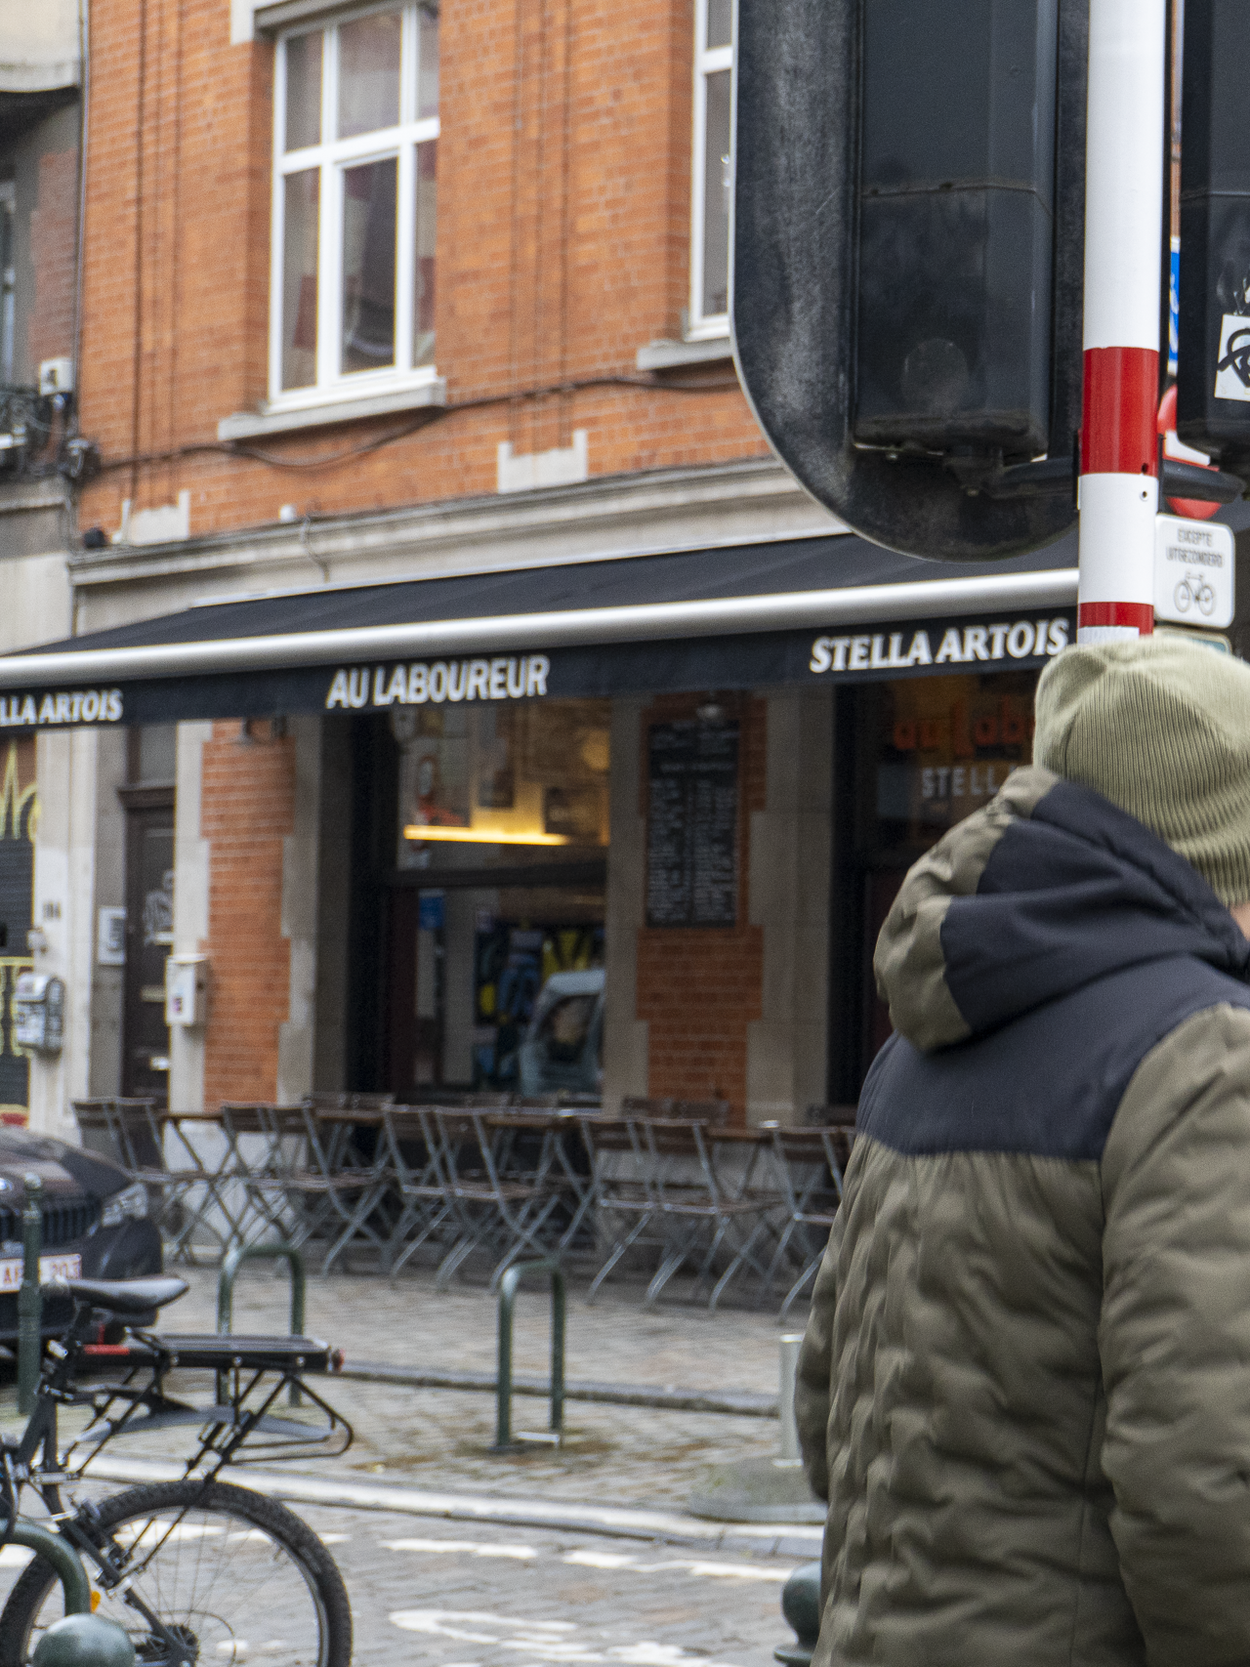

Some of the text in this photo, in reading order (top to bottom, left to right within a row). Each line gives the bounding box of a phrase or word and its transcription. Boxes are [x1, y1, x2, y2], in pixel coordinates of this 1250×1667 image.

[809, 618, 1070, 673] STELLA ARTOIS
[325, 655, 550, 709] AU LABOUREUR
[38, 688, 124, 724] ARTOIS
[921, 765, 1018, 799] STELL
